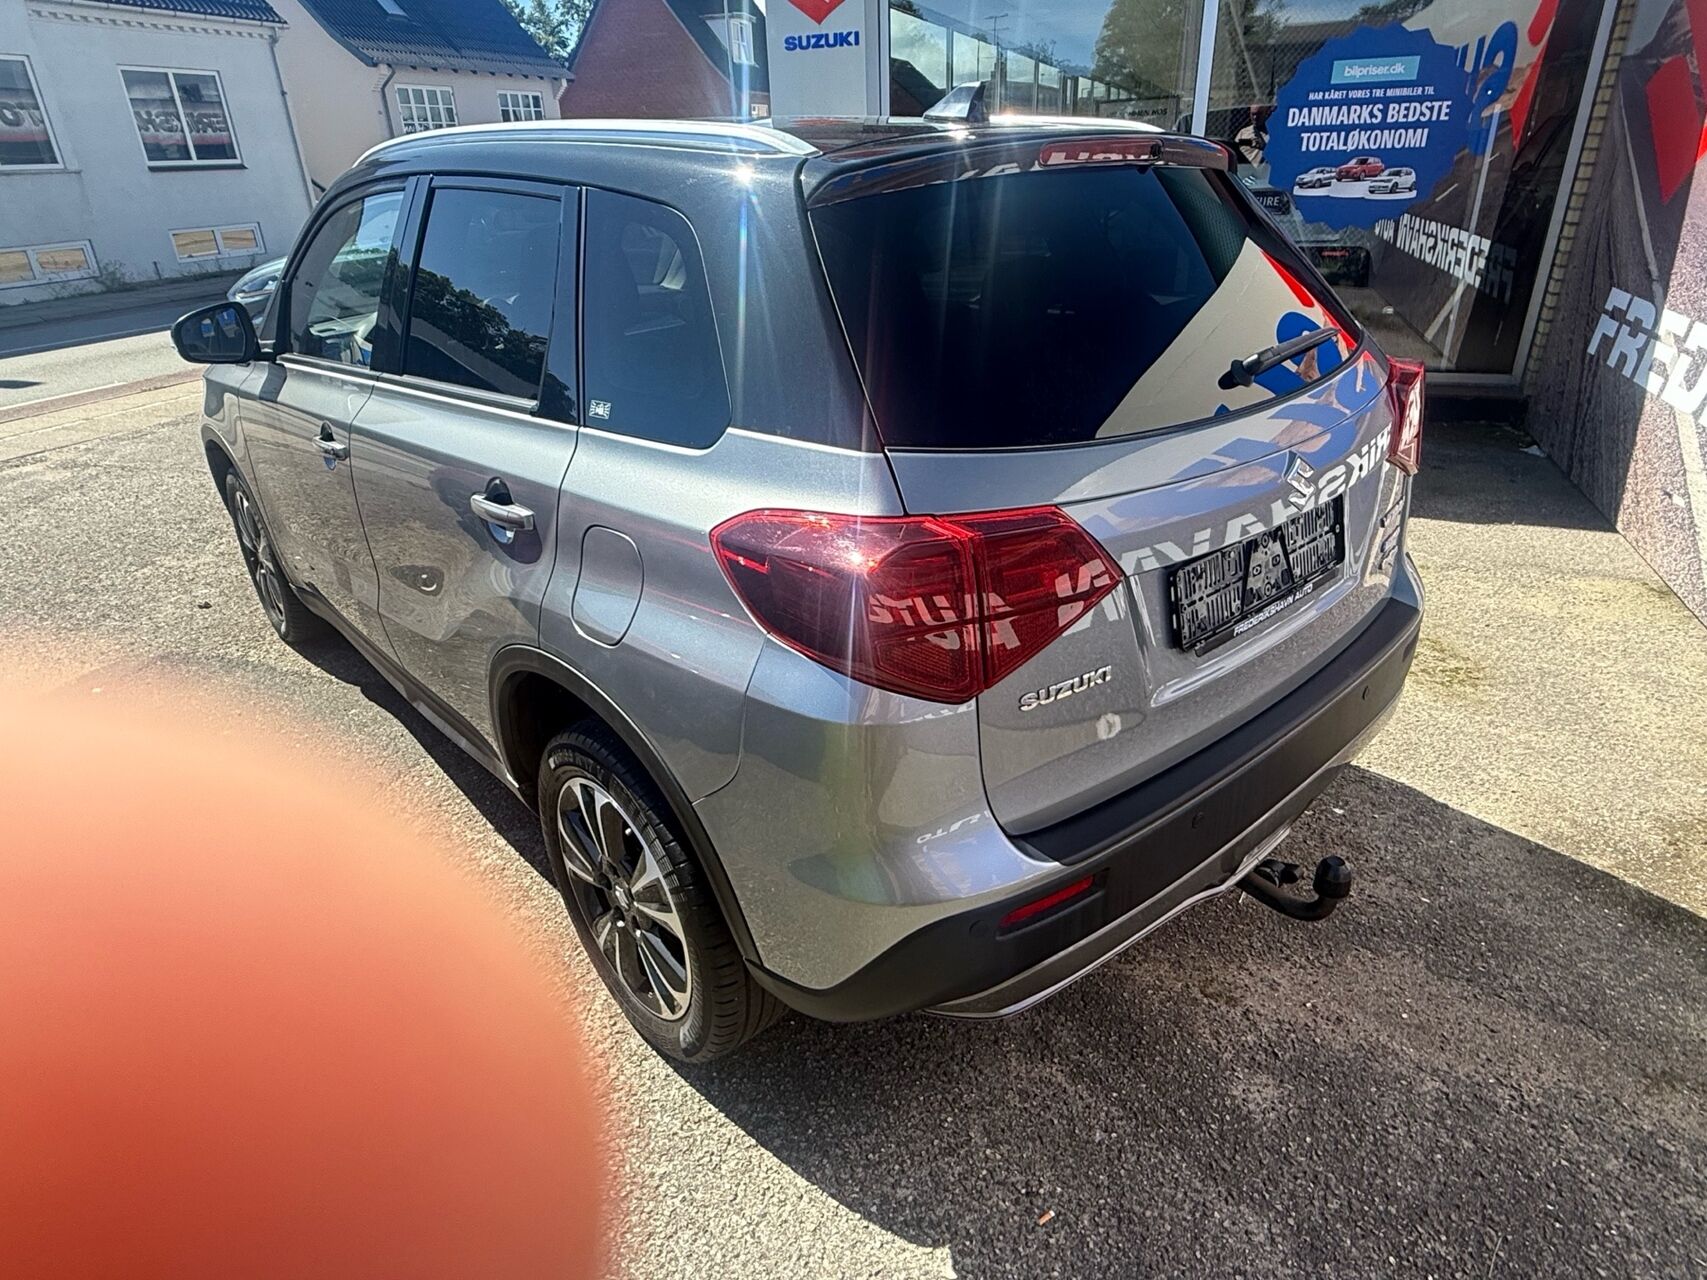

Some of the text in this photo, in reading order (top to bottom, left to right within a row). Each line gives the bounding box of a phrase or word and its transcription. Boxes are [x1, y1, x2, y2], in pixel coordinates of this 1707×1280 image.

[784, 31, 860, 51] SUZUKI
[1344, 63, 1405, 79] bilpriser.dk
[1308, 86, 1435, 100] HAR KÅRET VORES TRE MINIBILER TIL
[1287, 101, 1452, 127] DANMARKS BEDSTE
[1301, 128, 1429, 152] TOTALØKONOMI
[1587, 287, 1707, 428] FRED
[1018, 665, 1112, 711] SUZUKI
